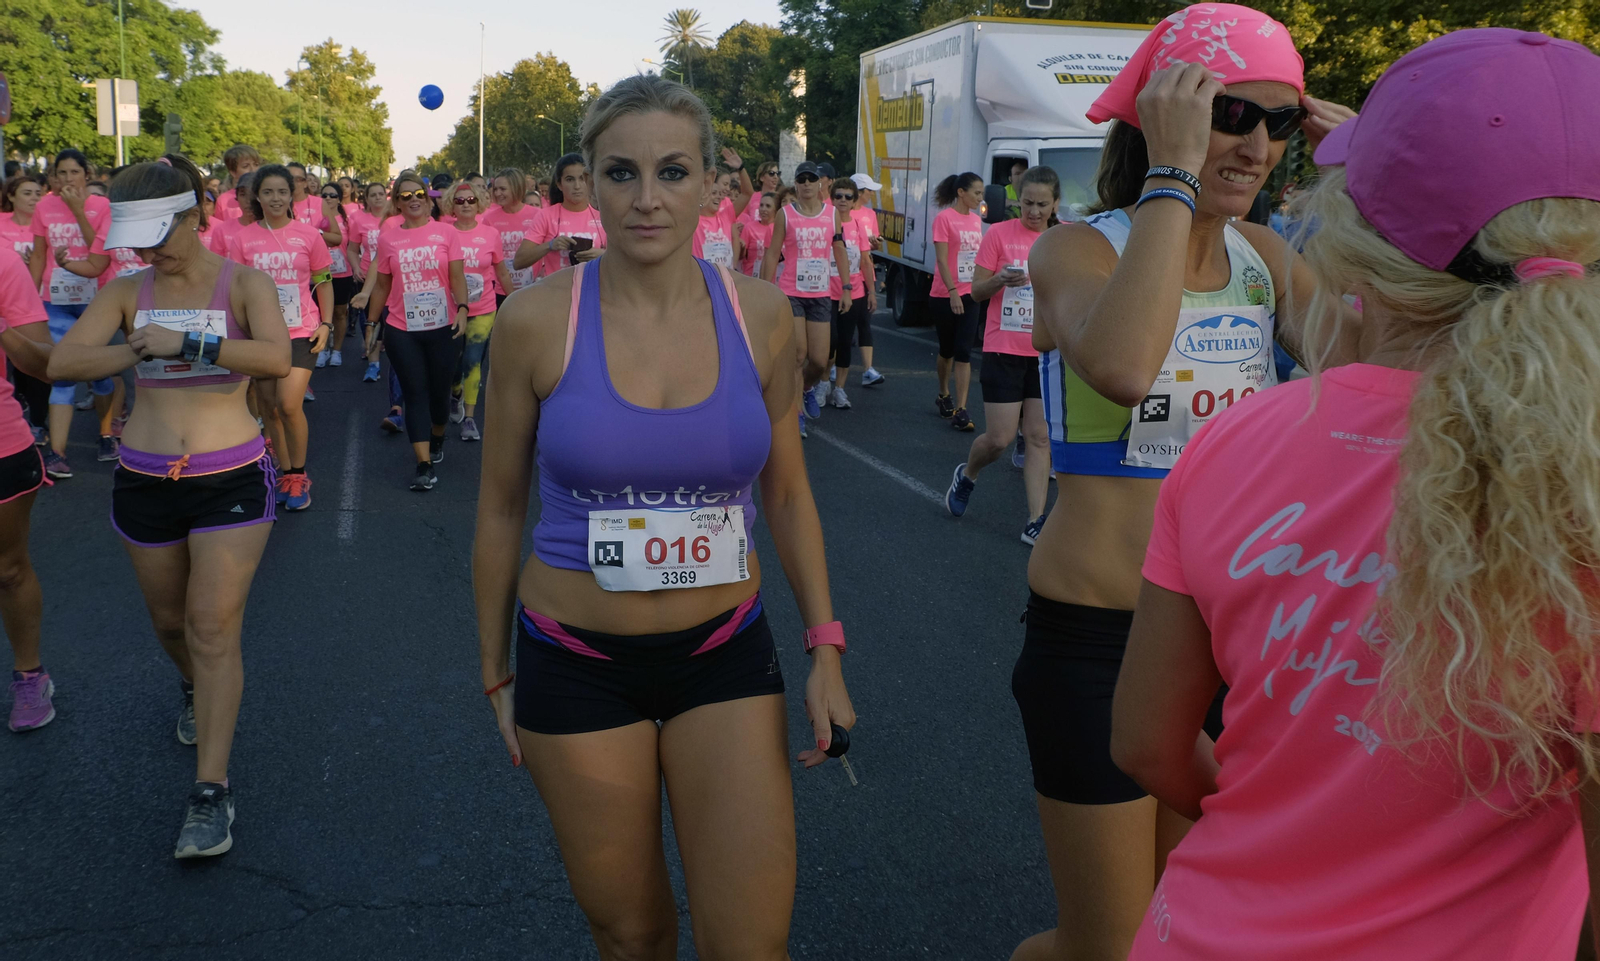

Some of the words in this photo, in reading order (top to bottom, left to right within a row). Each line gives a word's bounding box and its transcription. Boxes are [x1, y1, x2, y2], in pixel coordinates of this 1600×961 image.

[925, 35, 962, 64] CONDUCTOR
[1037, 53, 1085, 70] ALQUILER
[796, 227, 828, 241] HOY
[253, 252, 298, 269] HOY
[399, 245, 438, 263] HOY
[402, 271, 422, 284] LAS
[404, 279, 440, 292] CHICAS
[419, 308, 437, 318] 016
[1018, 307, 1032, 316] 01
[1183, 334, 1260, 353] ASTURIANA
[690, 511, 717, 523] Carrera
[706, 521, 725, 537] Mujer
[645, 536, 711, 565] 016
[661, 570, 697, 585] 3369
